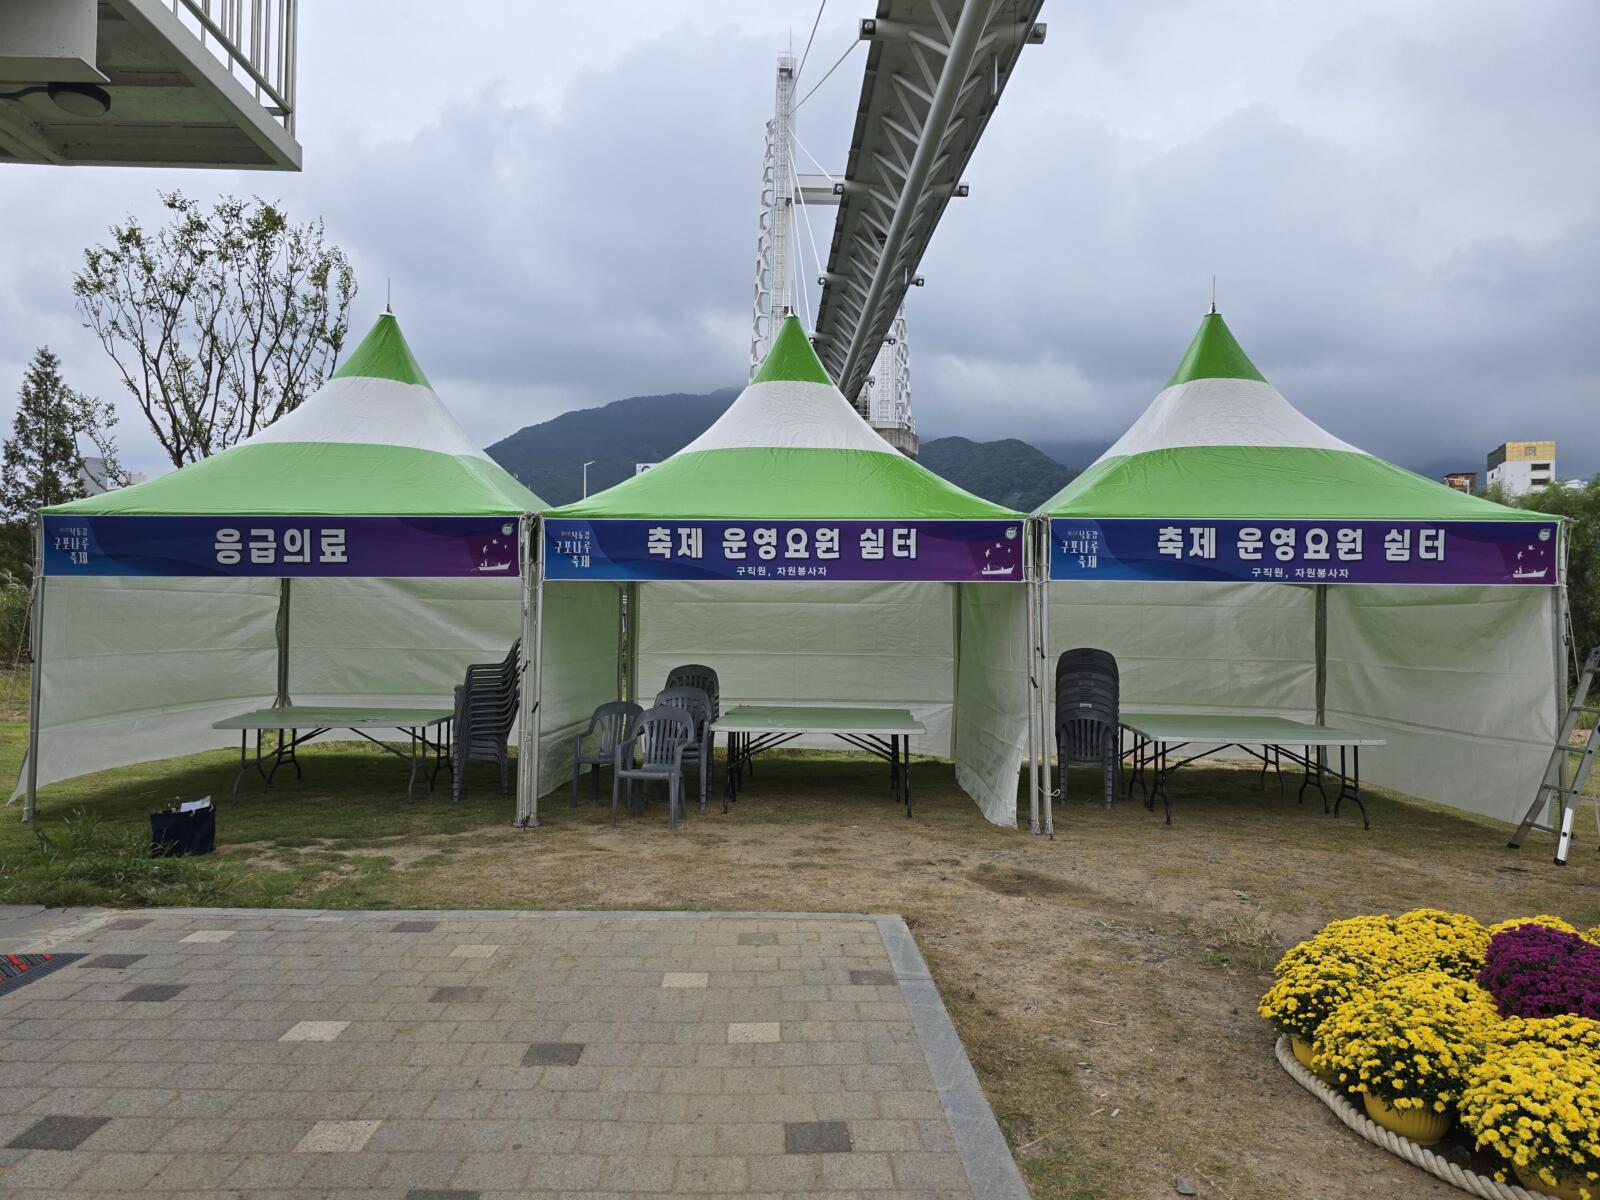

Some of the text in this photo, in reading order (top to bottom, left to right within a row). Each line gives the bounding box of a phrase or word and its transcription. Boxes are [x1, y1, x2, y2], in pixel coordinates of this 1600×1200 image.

[214, 528, 348, 565] 응급의료
[554, 540, 592, 554] 구포나루
[647, 526, 917, 560] 축제 운영요원 쉼터
[1060, 540, 1099, 554] 구포나루
[1157, 526, 1446, 562] 축제 운영요원 쉼터
[572, 555, 590, 568] 축제
[1077, 555, 1097, 568] 축제
[776, 566, 828, 577] 자원봉사자
[1294, 567, 1350, 579] 자원봉사자
